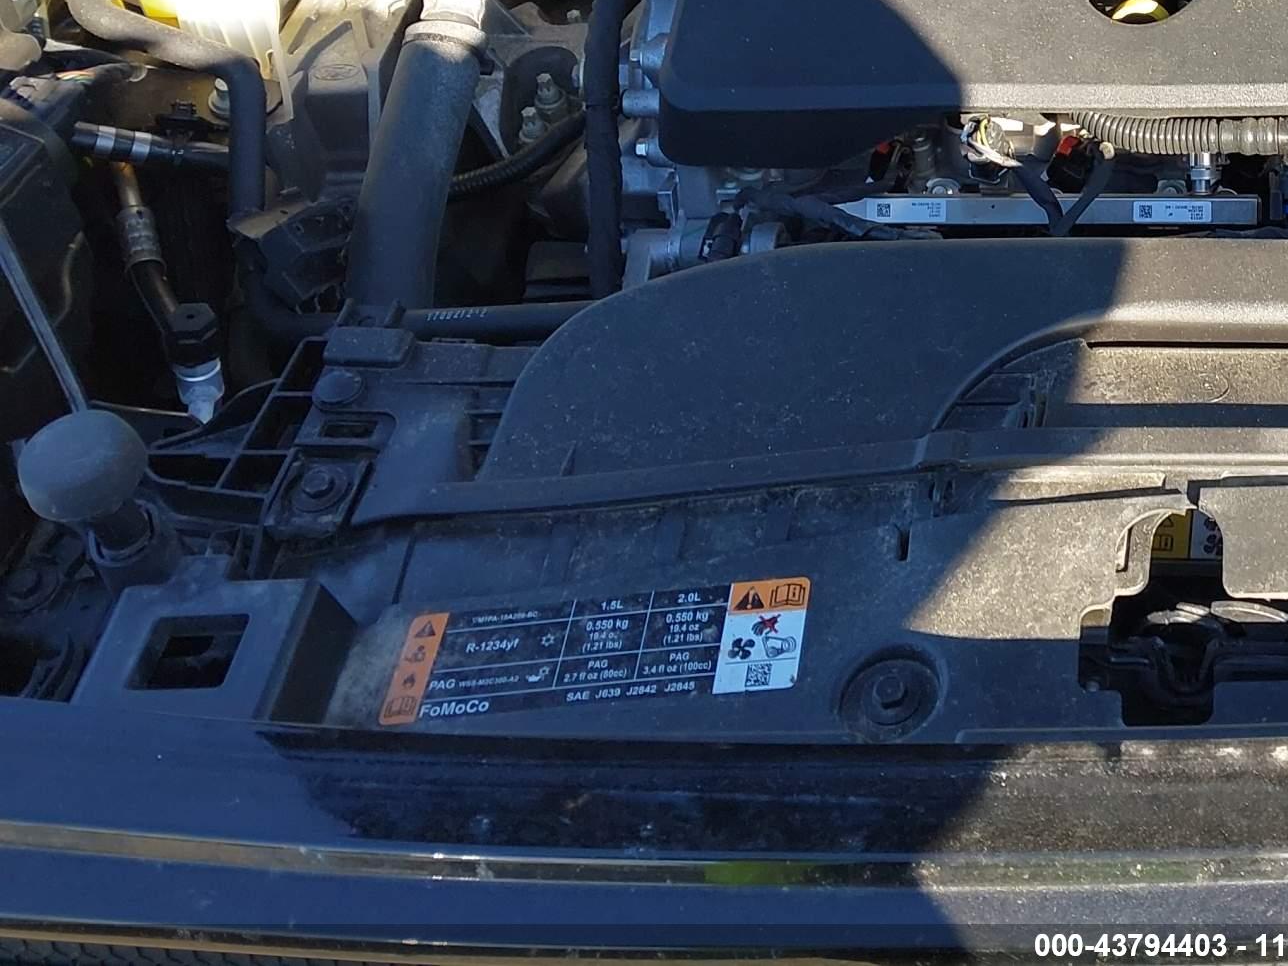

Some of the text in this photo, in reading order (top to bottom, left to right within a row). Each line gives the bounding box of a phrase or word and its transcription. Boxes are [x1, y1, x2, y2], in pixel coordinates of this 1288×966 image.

[677, 592, 701, 604] 2.0L
[666, 611, 709, 624] 0.550 kg
[586, 619, 629, 632] 0.550 kg
[669, 625, 687, 634] 19.4
[466, 638, 520, 654] R-1234yf
[663, 634, 685, 646] (1.21
[669, 652, 690, 662] PAG
[588, 660, 608, 670] PAG
[643, 665, 657, 675] 3.4
[679, 661, 712, 673] (100cc)
[428, 678, 456, 691] PAG
[563, 673, 577, 683] 2.7
[566, 690, 591, 702] SAE
[595, 687, 621, 699] J639
[418, 699, 490, 719] FoMoCo
